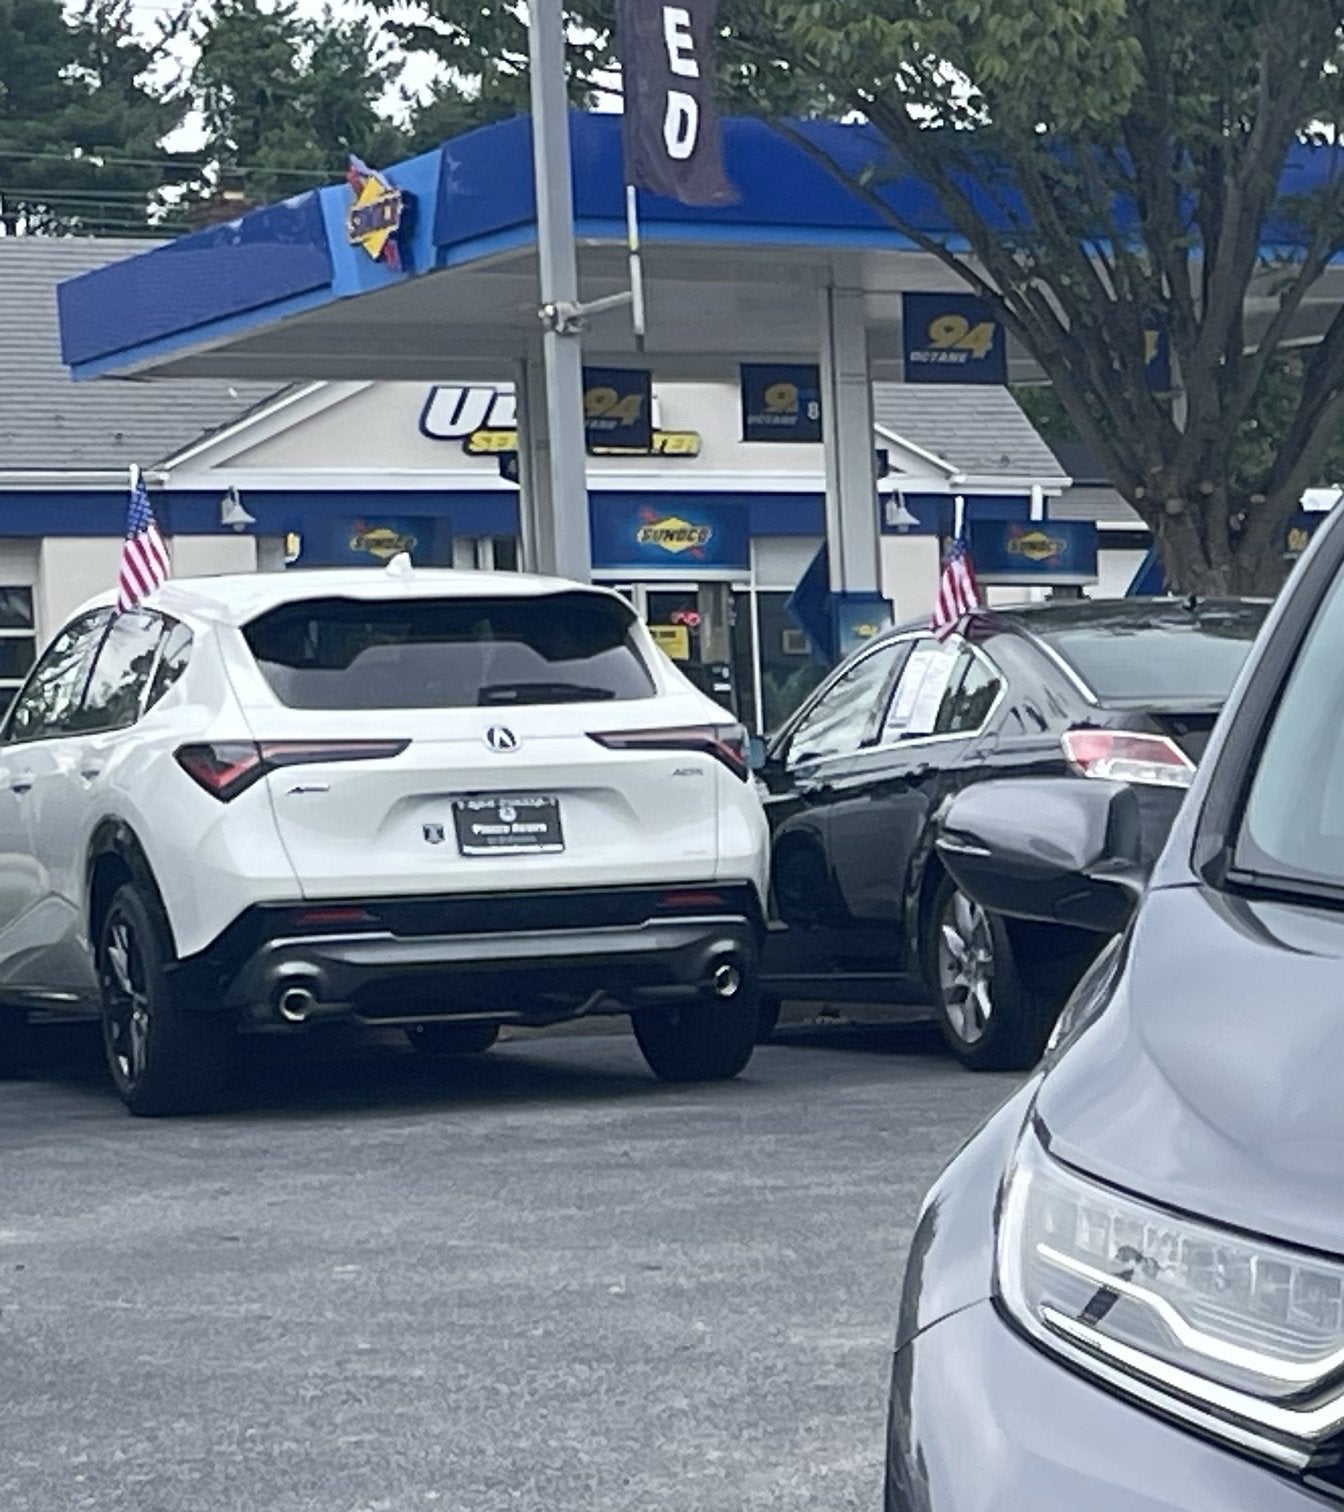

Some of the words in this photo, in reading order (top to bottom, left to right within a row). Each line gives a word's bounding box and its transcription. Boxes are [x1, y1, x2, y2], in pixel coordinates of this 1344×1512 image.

[927, 314, 996, 360] 94
[909, 351, 969, 363] OCTANE
[584, 387, 644, 426] 94
[638, 526, 712, 544] SUNOCO
